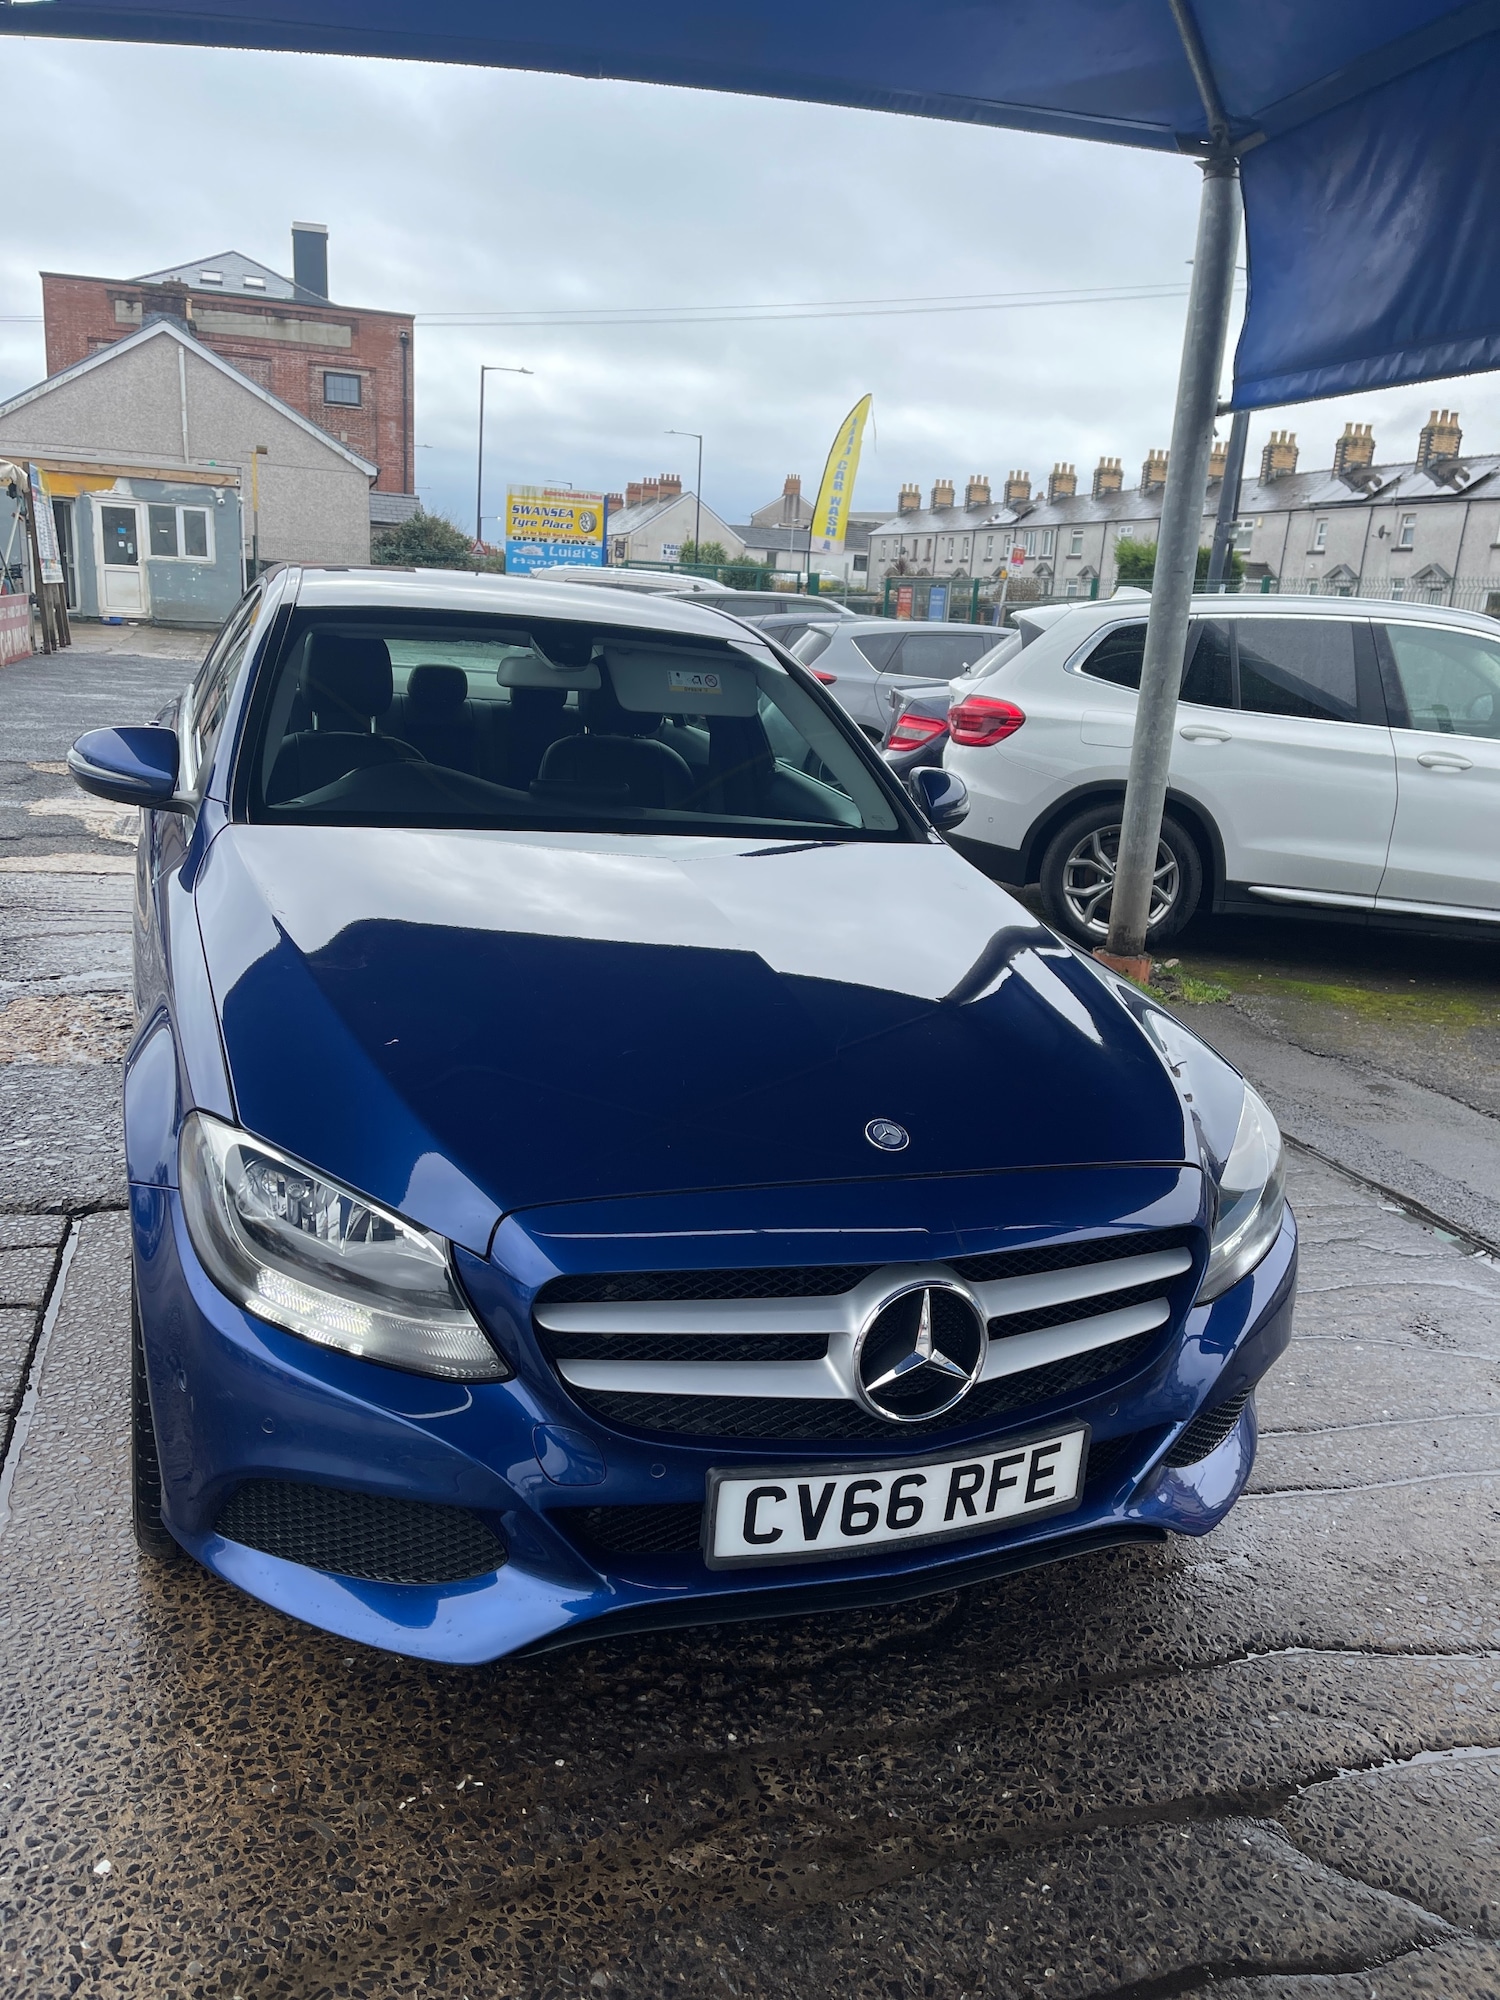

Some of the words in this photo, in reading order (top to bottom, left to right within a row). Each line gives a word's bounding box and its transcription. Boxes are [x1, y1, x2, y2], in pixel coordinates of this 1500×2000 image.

[833, 460, 848, 491] CAR
[512, 504, 574, 518] SWANSEA
[825, 496, 842, 537] WASH
[512, 517, 538, 527] Tyre
[542, 519, 574, 529] Place
[549, 546, 599, 559] Luigi's
[512, 557, 558, 566] Hand
[742, 1473, 928, 1545] CV66
[943, 1442, 1063, 1521] RFE
